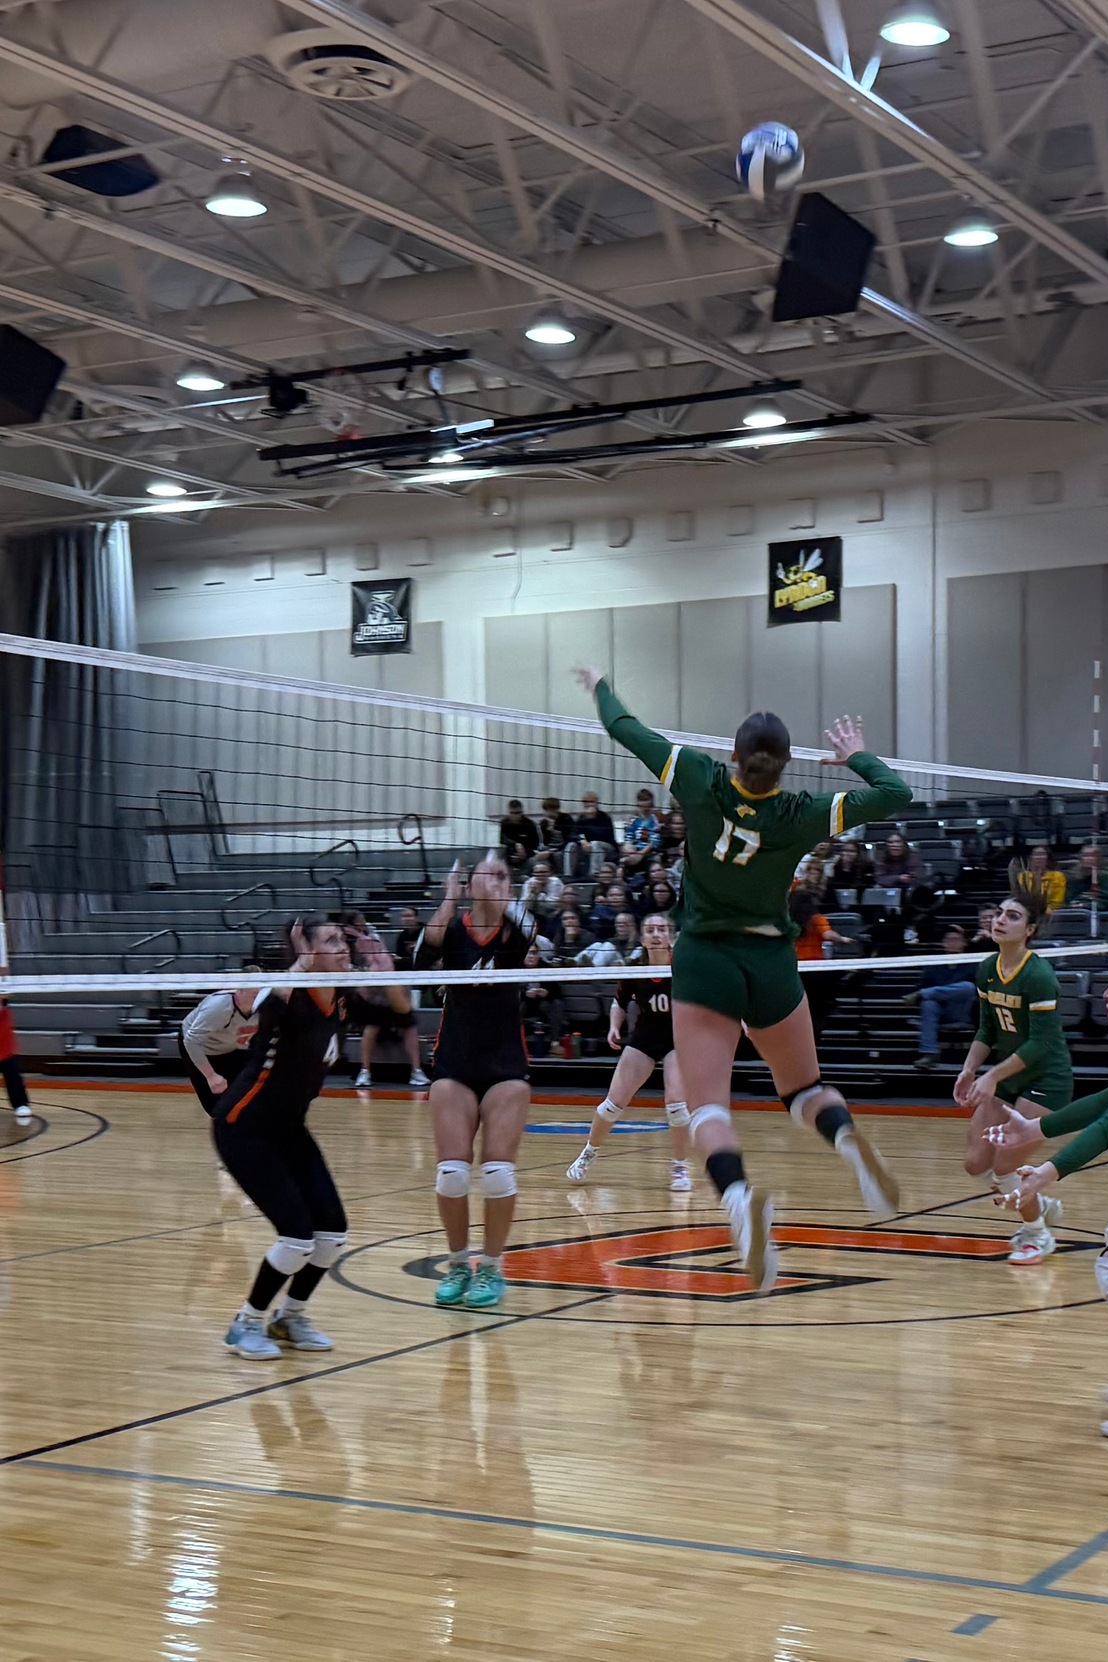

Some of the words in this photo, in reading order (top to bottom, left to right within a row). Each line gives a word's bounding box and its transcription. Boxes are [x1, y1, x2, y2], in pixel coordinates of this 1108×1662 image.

[712, 815, 761, 867] 17
[648, 993, 670, 1012] 10
[995, 1007, 1018, 1033] 12
